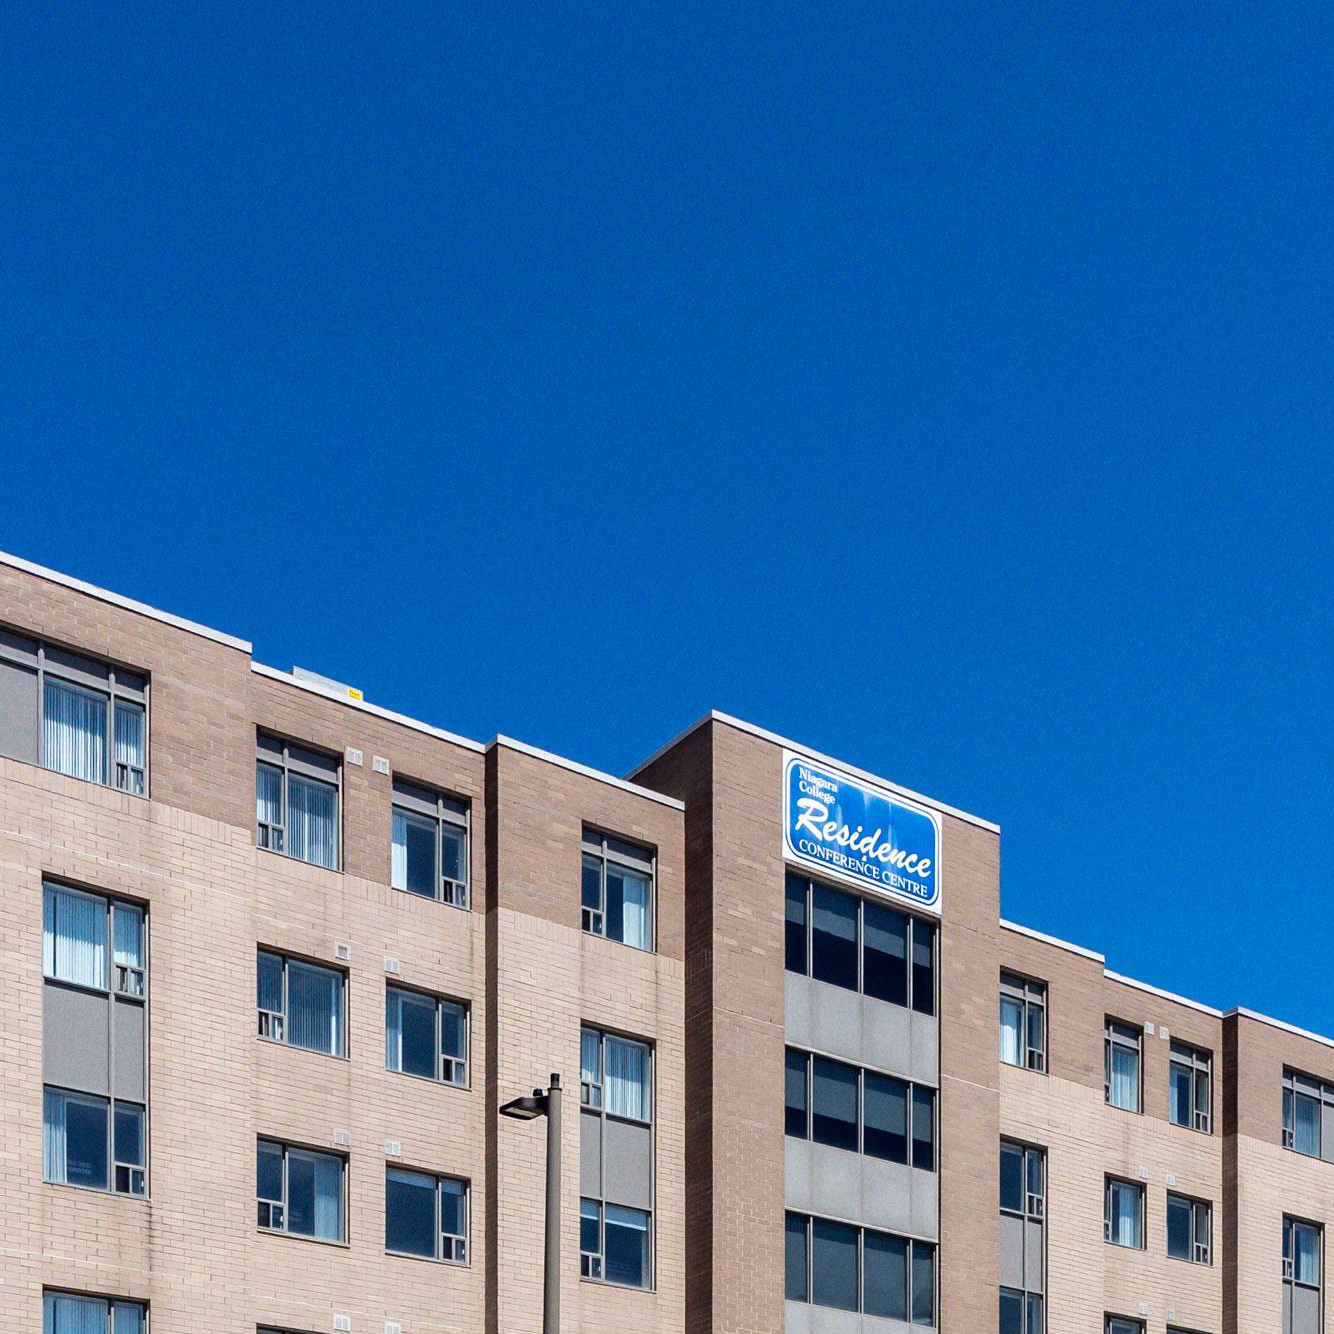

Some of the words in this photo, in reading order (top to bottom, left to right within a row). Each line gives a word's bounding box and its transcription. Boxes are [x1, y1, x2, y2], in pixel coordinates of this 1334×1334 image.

[798, 766, 838, 793] Niagara
[798, 780, 836, 805] College
[794, 797, 932, 878] Residence
[798, 838, 880, 880] CONFERENCE
[881, 870, 928, 898] CENTRE
